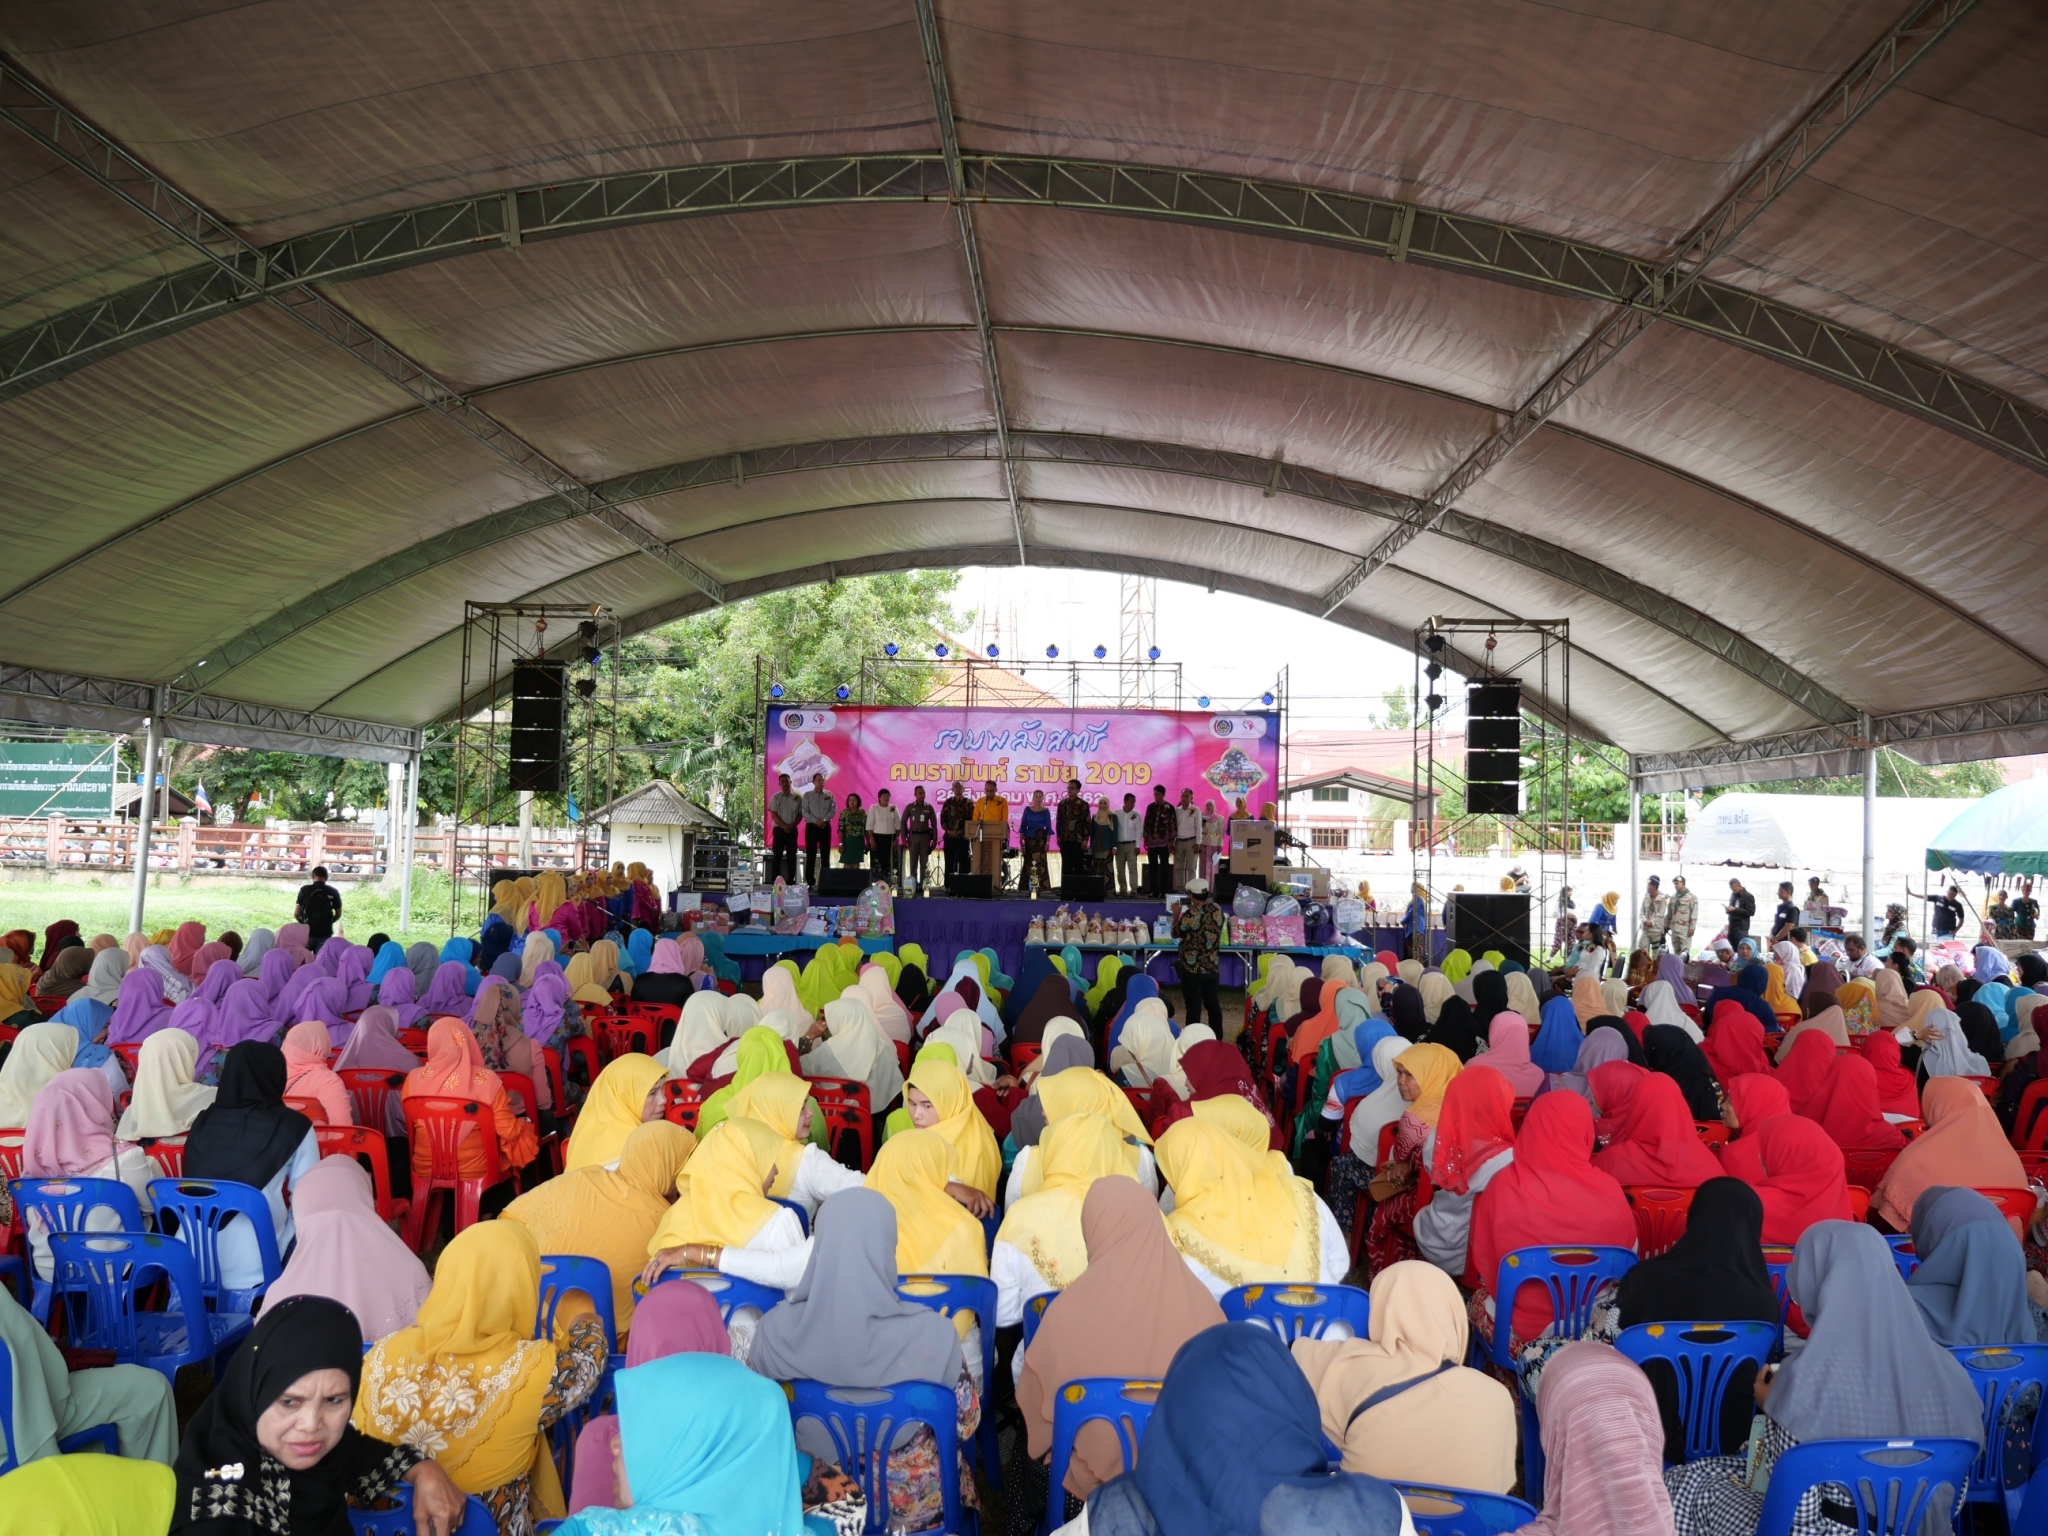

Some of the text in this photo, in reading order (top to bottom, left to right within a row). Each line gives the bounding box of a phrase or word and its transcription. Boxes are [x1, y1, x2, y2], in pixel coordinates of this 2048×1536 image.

[934, 719, 1109, 752] รวมพลังสตรี
[890, 756, 1152, 785] คนรามันห์ รามัย 2019
